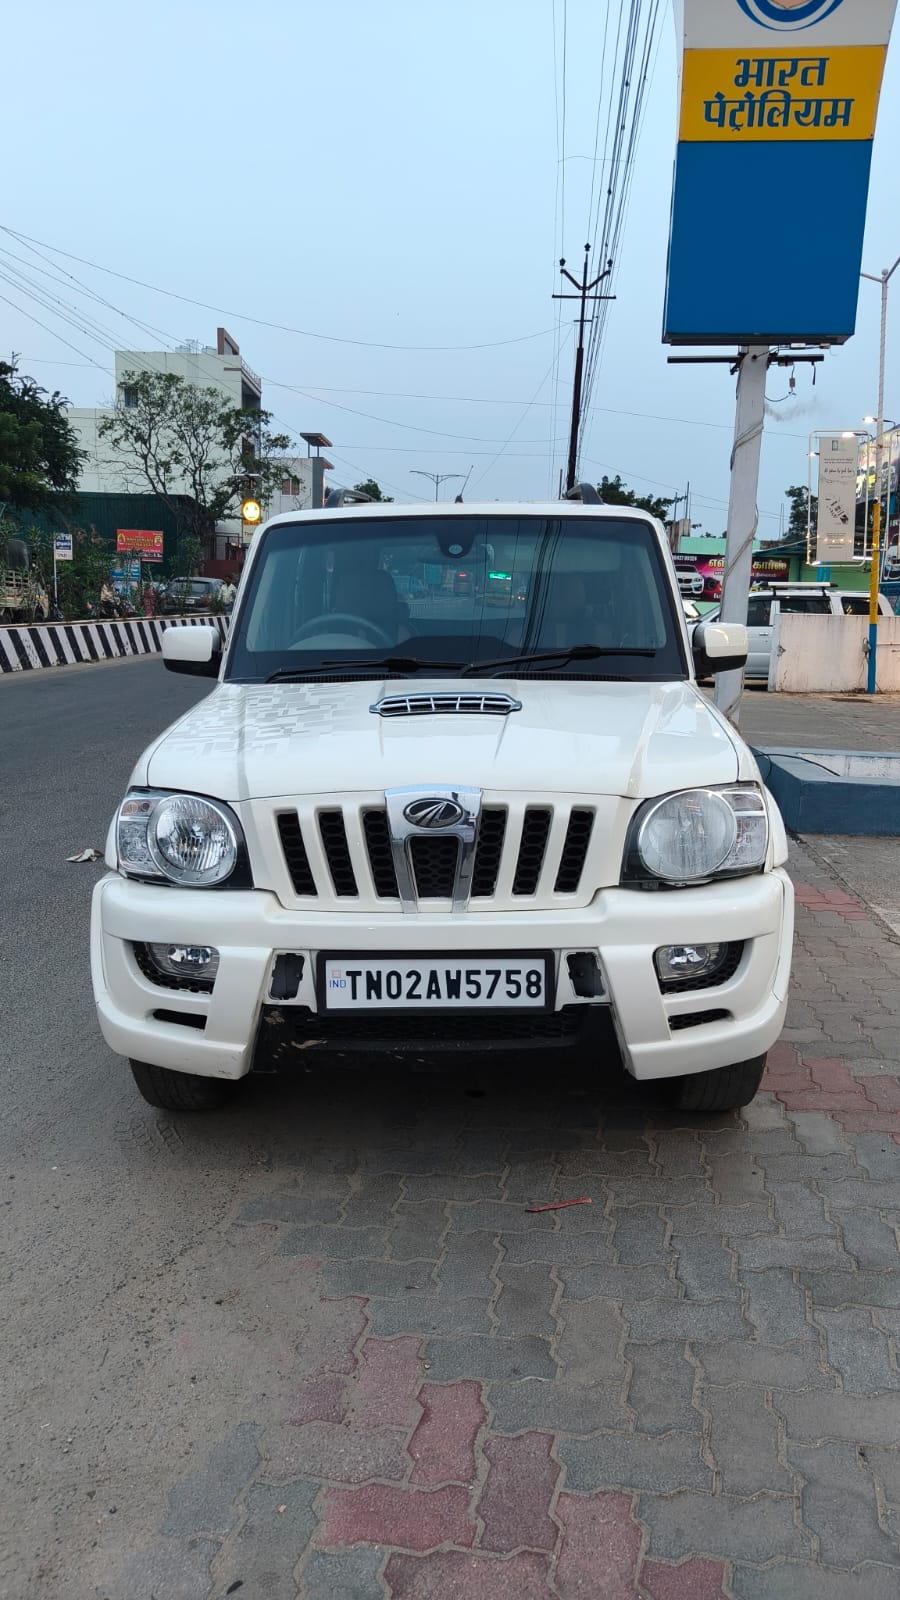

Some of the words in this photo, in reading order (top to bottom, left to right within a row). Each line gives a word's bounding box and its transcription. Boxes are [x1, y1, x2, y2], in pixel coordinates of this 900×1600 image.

[734, 57, 830, 88] भारत
[703, 89, 855, 131] पेट्रोलियम
[329, 979, 346, 989] IND
[346, 969, 542, 1001] TN02AW5758
